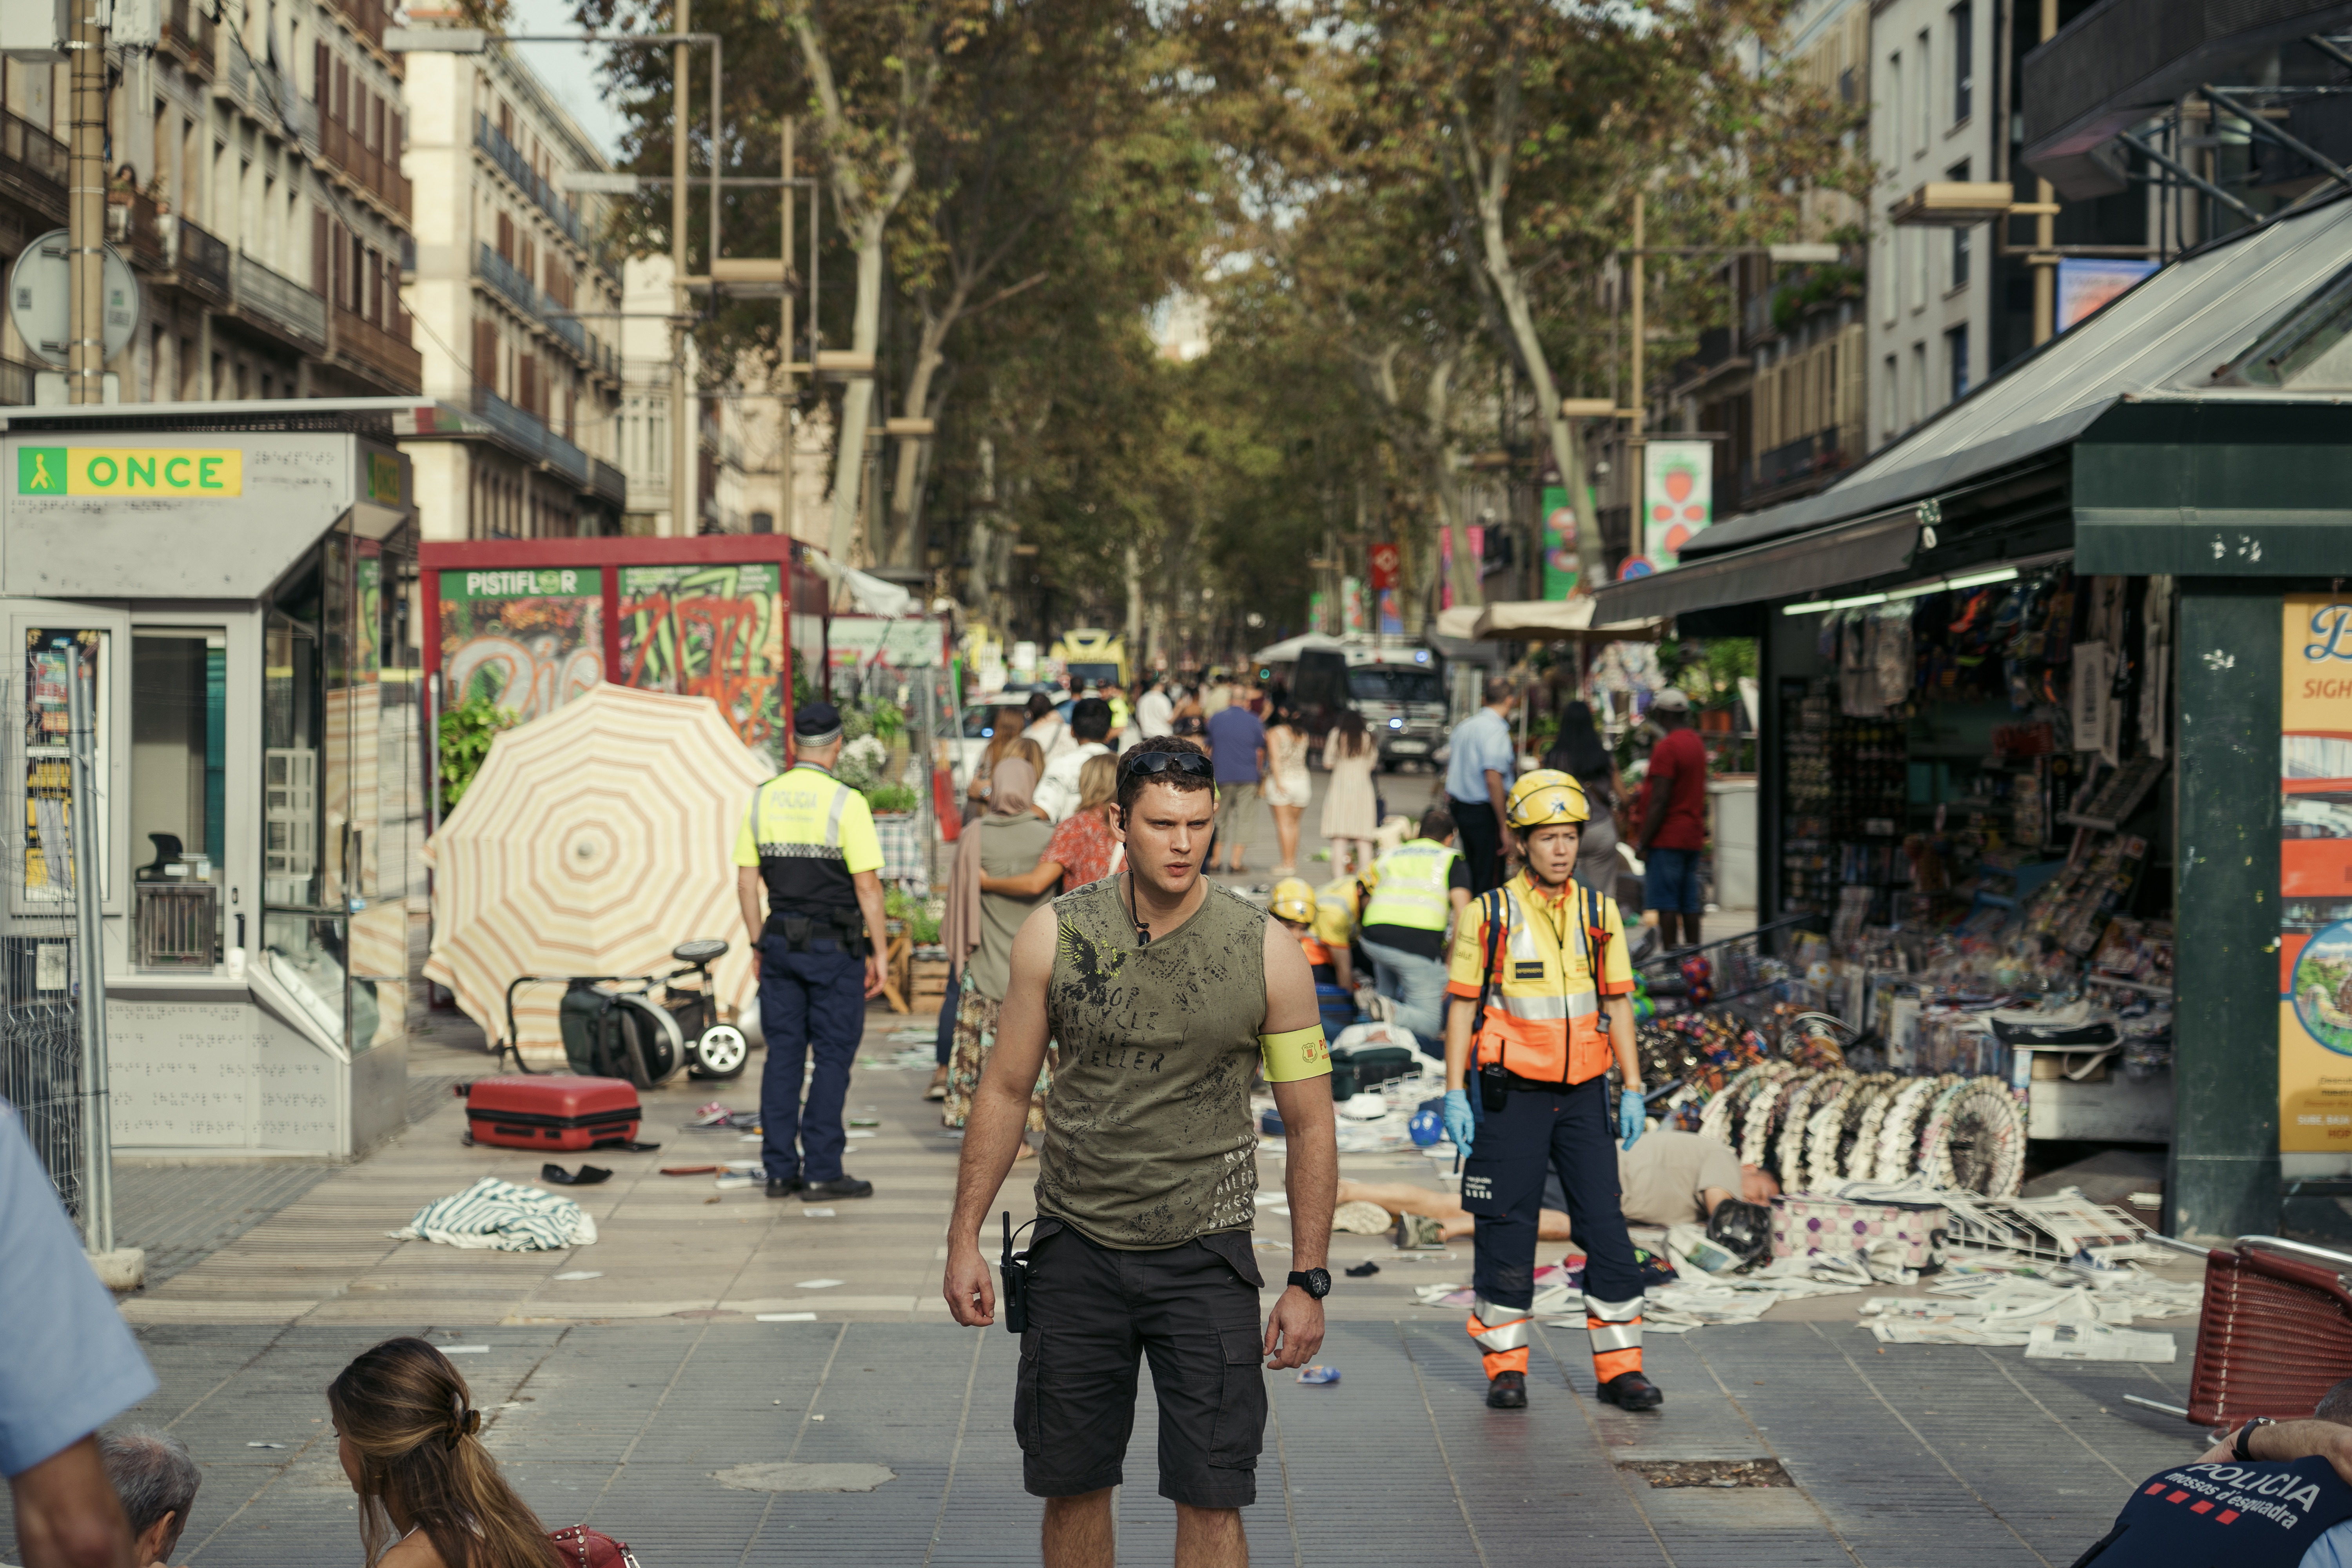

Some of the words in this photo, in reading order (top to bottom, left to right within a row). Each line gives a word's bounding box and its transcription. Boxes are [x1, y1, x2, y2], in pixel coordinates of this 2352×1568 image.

[87, 457, 224, 488] ONCE
[2303, 678, 2352, 699] SIGH
[2165, 1472, 2220, 1495] mossos
[2215, 1490, 2299, 1530] d'esquadra
[2185, 1463, 2320, 1513] POLICIA
